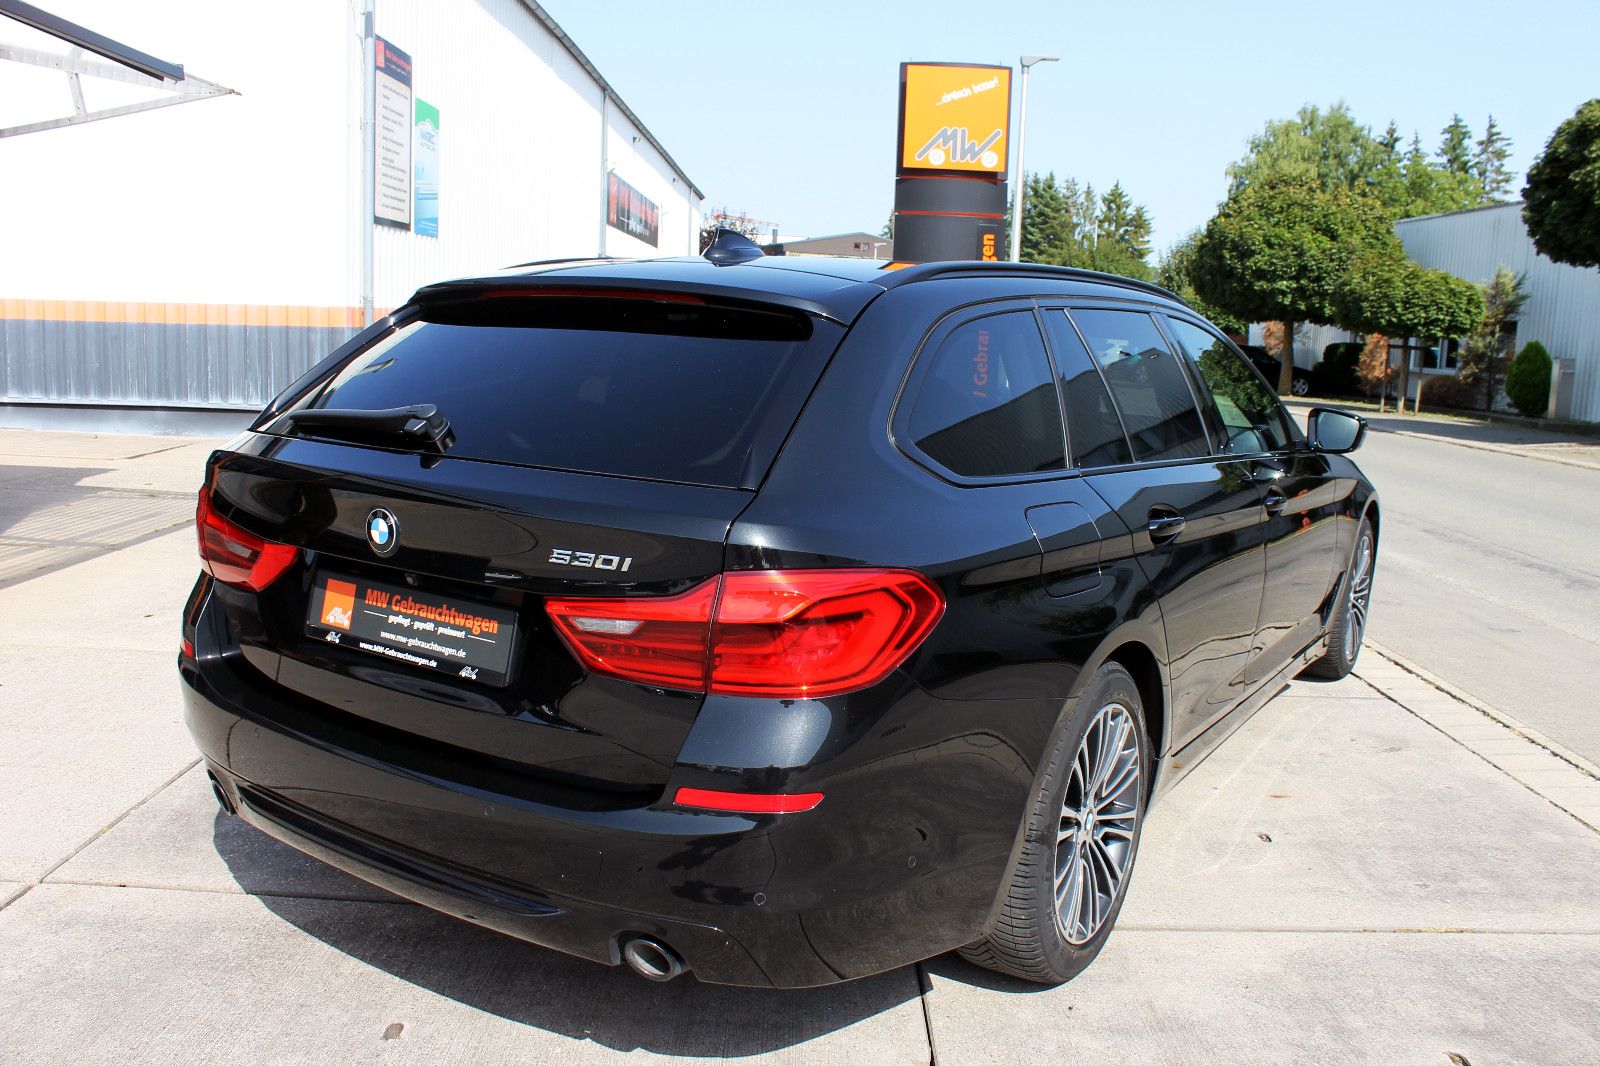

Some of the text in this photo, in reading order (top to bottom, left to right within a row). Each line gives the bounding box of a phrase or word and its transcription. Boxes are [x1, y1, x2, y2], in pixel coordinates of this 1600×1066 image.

[915, 126, 1003, 163] MW
[365, 588, 499, 635] MW Gebrauchtwagen
[380, 630, 467, 658] www.mw-gebrauchtwagen.de
